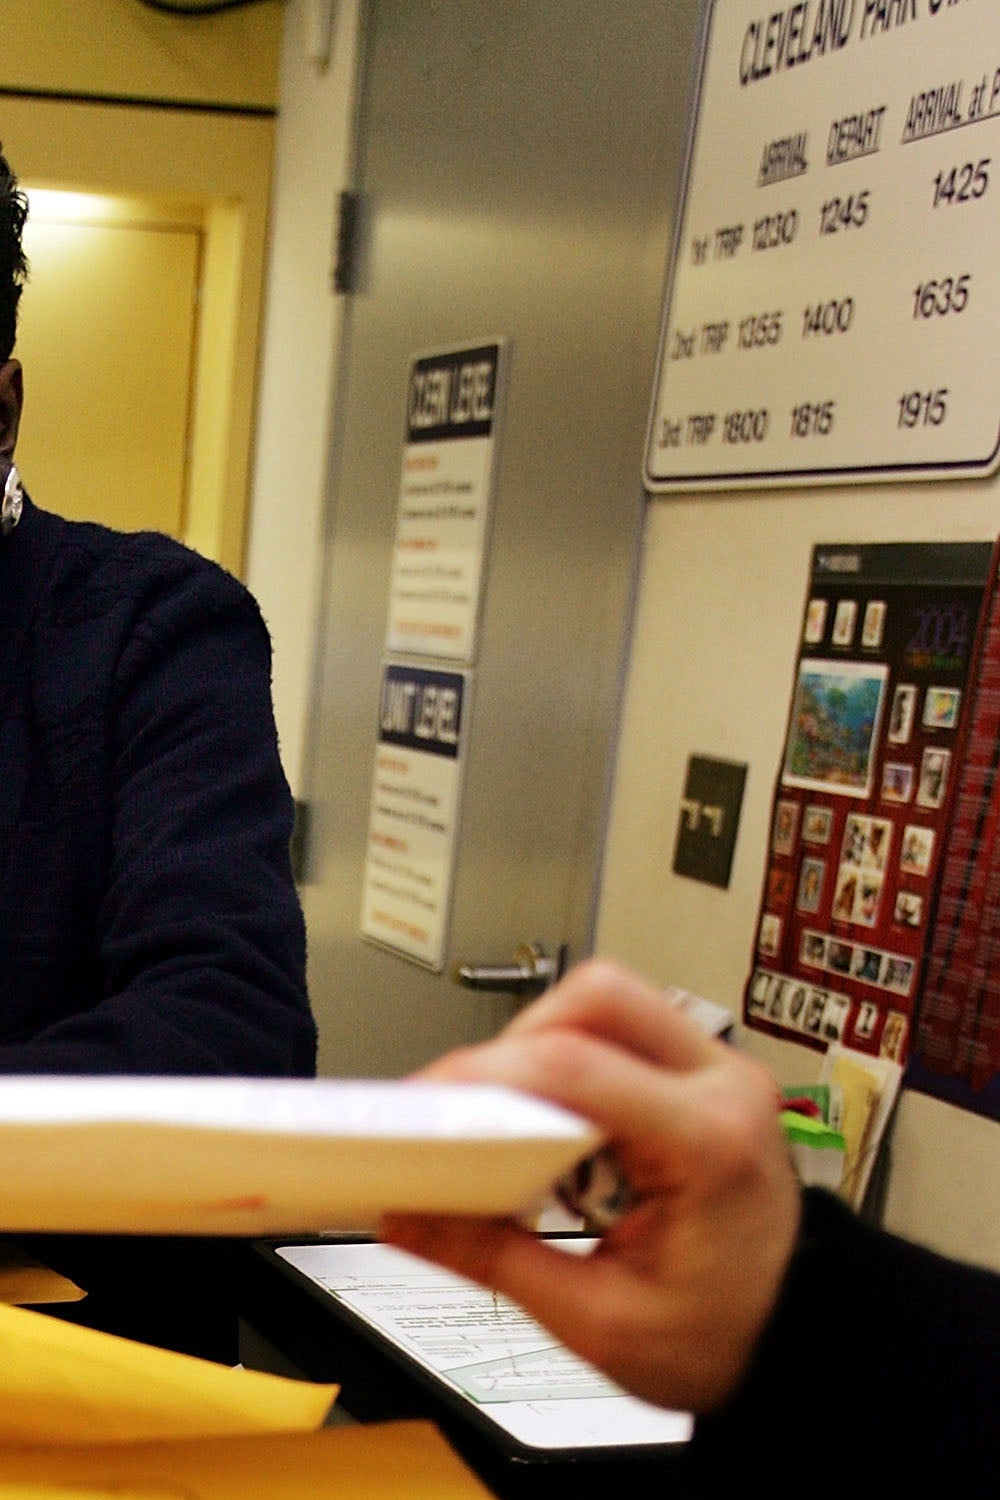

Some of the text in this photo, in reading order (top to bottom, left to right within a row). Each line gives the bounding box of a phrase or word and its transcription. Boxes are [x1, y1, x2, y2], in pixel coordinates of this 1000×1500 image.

[739, 0, 853, 87] CLEVELAND
[826, 105, 886, 160] DEPART
[904, 80, 962, 138] ARRIVAL
[967, 73, 987, 119] at
[752, 209, 797, 251] 1230
[820, 190, 870, 235] 1245
[932, 158, 991, 208] 1425
[738, 310, 784, 350] 1355
[802, 297, 854, 339] 1400
[913, 274, 971, 320] 1635
[723, 408, 768, 445] 1800
[789, 401, 836, 438] 1815
[898, 389, 949, 429] 1915
